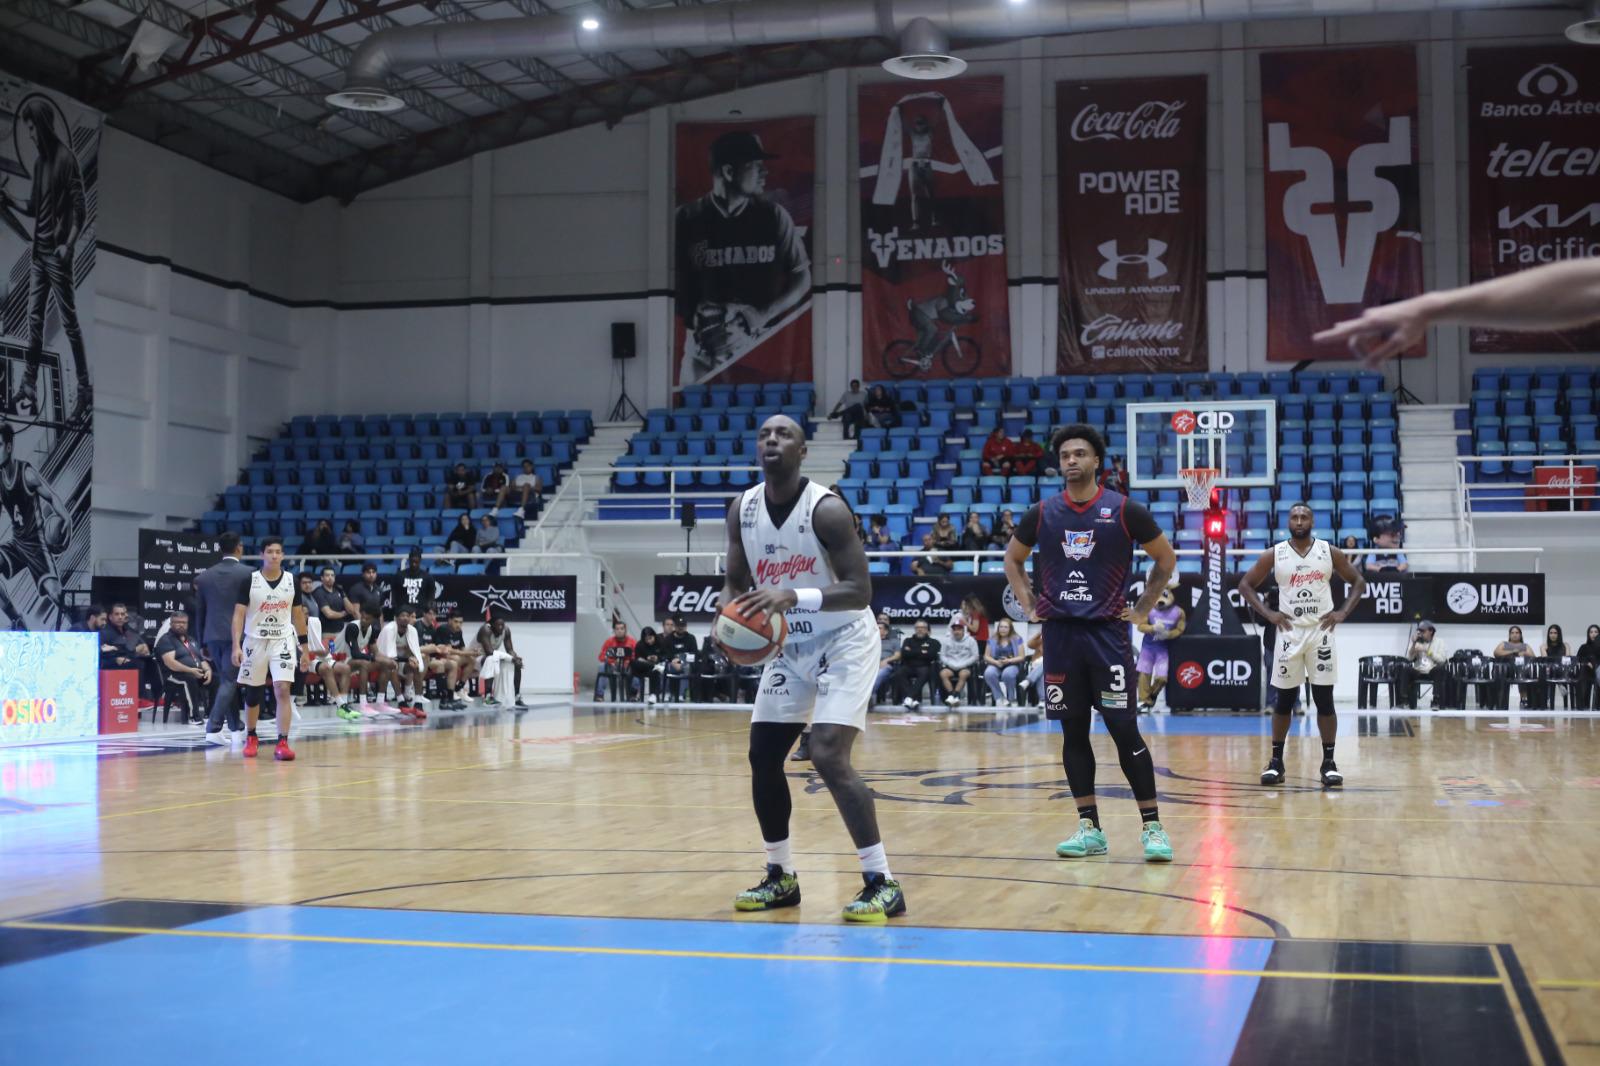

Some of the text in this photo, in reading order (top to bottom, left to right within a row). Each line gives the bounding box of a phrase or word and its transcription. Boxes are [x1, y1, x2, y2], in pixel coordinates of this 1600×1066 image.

[1480, 102, 1542, 117] Banco
[1071, 101, 1185, 141] Coca-Cola
[1079, 169, 1179, 194] POWER
[1125, 192, 1180, 215] ADE
[867, 226, 1003, 268] VENADOS
[1085, 285, 1180, 295] UNDER ARMOUR
[1081, 313, 1181, 346] Caliente
[1106, 346, 1180, 358] caliente.mx
[1197, 411, 1234, 429] CID
[402, 578, 423, 588] JUST
[1206, 538, 1224, 634] dportenis
[1344, 582, 1403, 598] OWE
[507, 590, 565, 599] AMERICAN
[1060, 591, 1092, 601] flecha
[1481, 584, 1528, 606] UAD
[521, 600, 566, 609] FITNESS
[1481, 606, 1529, 614] MAZATLAN
[883, 607, 920, 618] Banco
[1110, 664, 1126, 691] 3
[1207, 660, 1252, 680] CID
[762, 688, 790, 696] MEGA
[1047, 703, 1068, 711] MEGA
